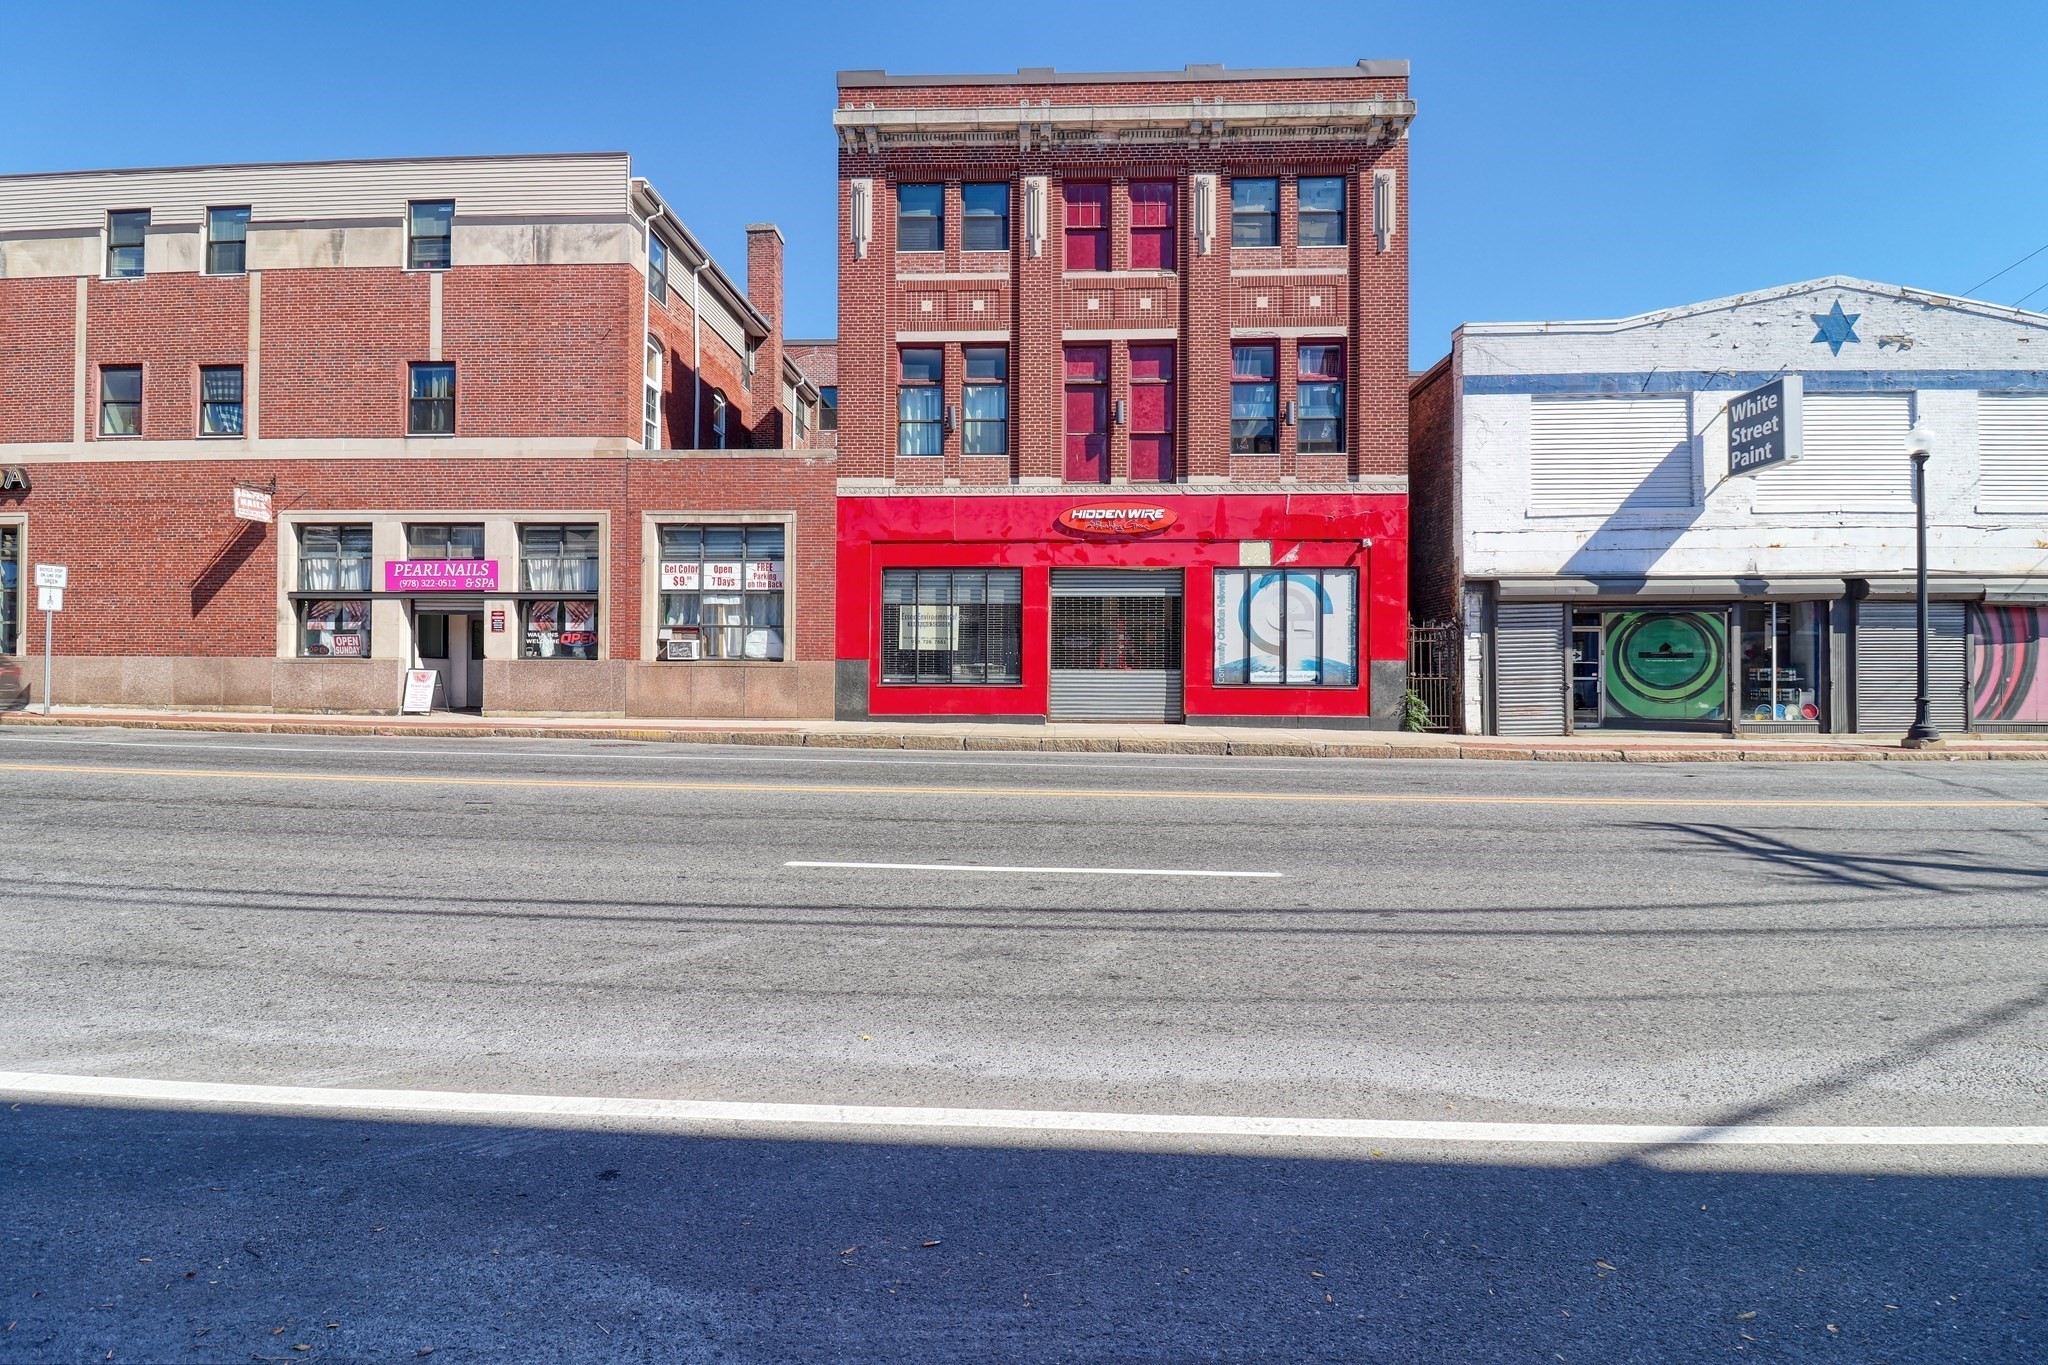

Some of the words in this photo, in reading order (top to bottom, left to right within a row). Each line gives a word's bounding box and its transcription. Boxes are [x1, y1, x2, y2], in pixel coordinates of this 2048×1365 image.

[1731, 394, 1778, 423] White
[1731, 415, 1779, 446] Street
[1731, 442, 1772, 470] Paint
[0, 466, 27, 489] A
[240, 498, 267, 510] NAILS
[1071, 509, 1127, 519] HIDDEN
[1128, 508, 1165, 521] WIRE
[393, 563, 442, 577] PEARL
[444, 563, 490, 576] NAILS
[664, 564, 677, 574] Get
[678, 564, 699, 574] Color
[713, 565, 733, 575] Open
[757, 562, 773, 572] FREE
[753, 572, 777, 581] Parking
[400, 579, 420, 589] (978)
[420, 579, 457, 588] 322-0512
[711, 577, 716, 586] 7
[717, 577, 736, 588] Days
[756, 580, 767, 588] the
[767, 580, 783, 588] Back
[1216, 570, 1227, 608] Fellowship
[1216, 609, 1225, 641] Christian
[335, 636, 359, 647] OPEN
[560, 633, 598, 644] OPEN
[335, 646, 361, 655] SUNDAY
[1217, 641, 1227, 684] Community
